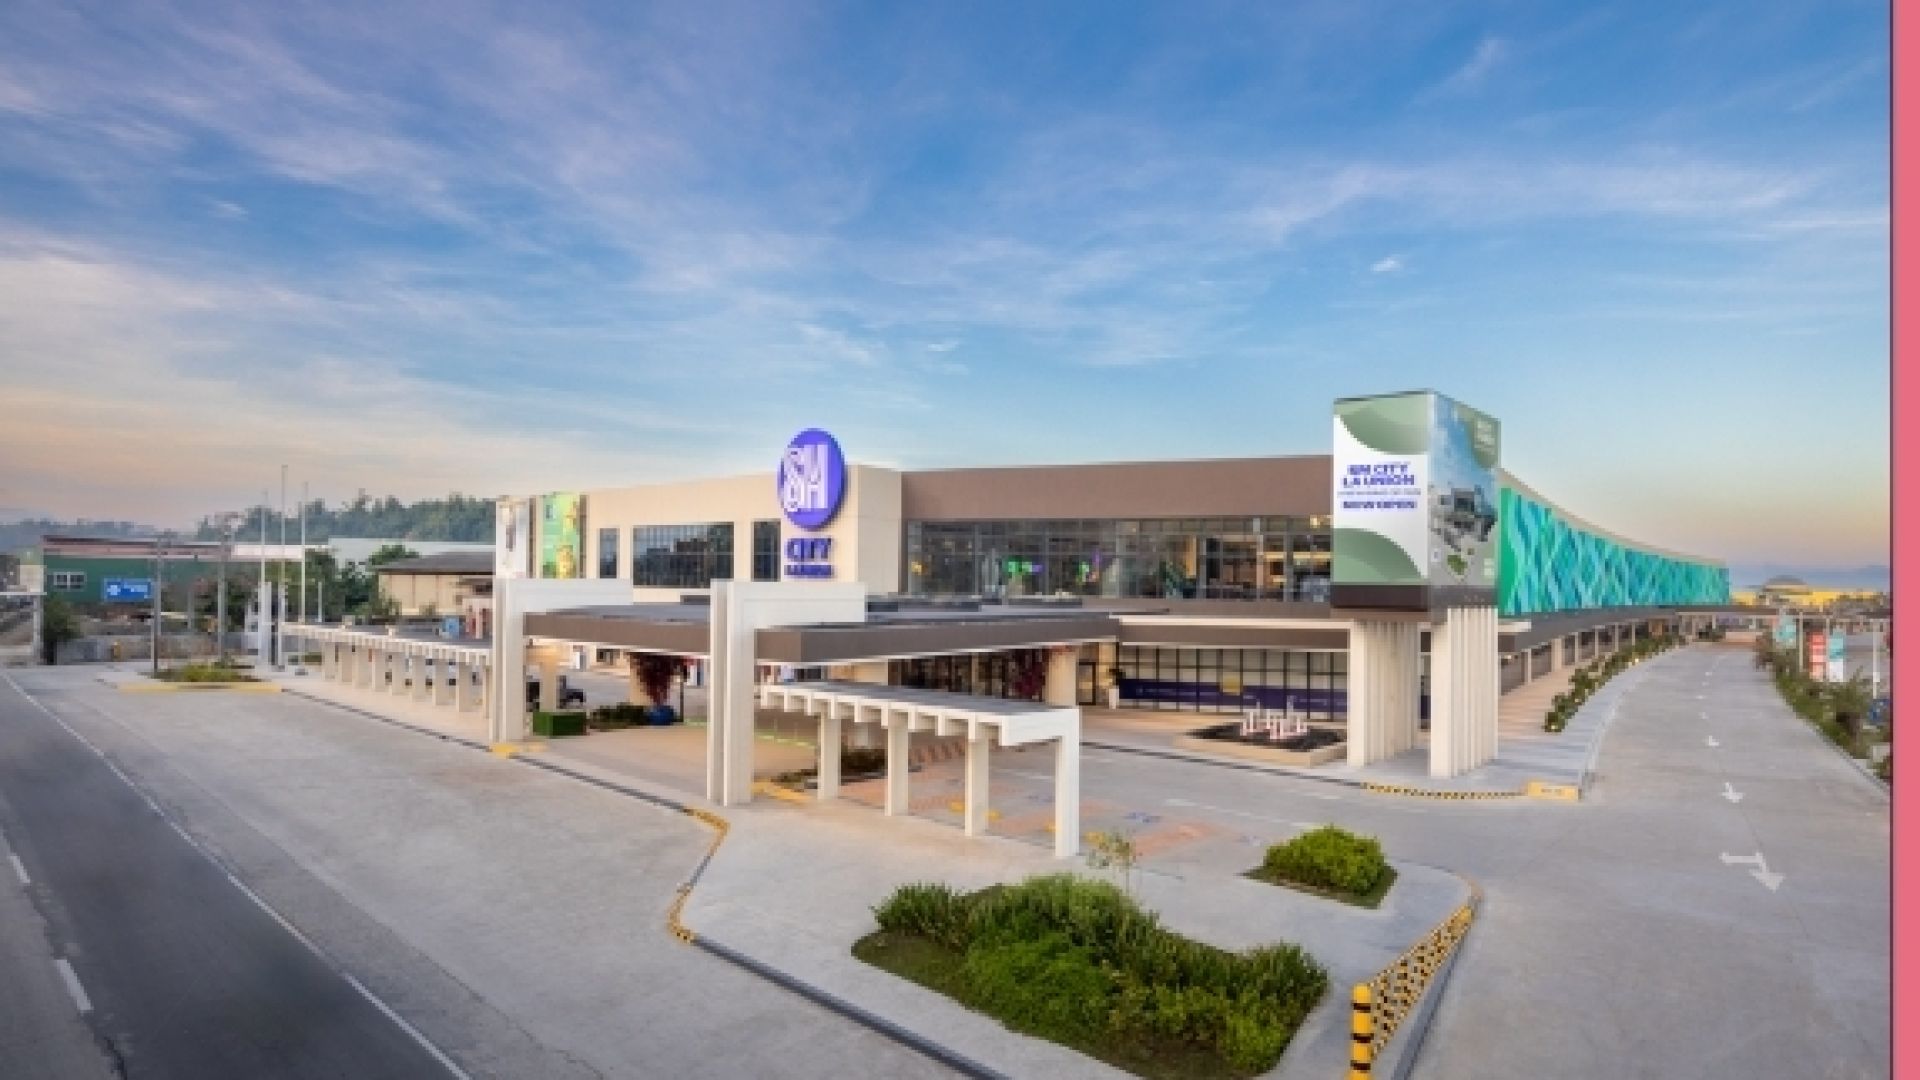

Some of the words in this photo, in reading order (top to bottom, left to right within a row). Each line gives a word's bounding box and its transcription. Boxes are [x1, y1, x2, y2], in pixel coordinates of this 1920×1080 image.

[1374, 464, 1409, 475] CITY
[1343, 475, 1361, 486] LA
[1363, 474, 1415, 486] UNION
[1343, 501, 1375, 509] NOW
[1377, 501, 1417, 509] OPEN
